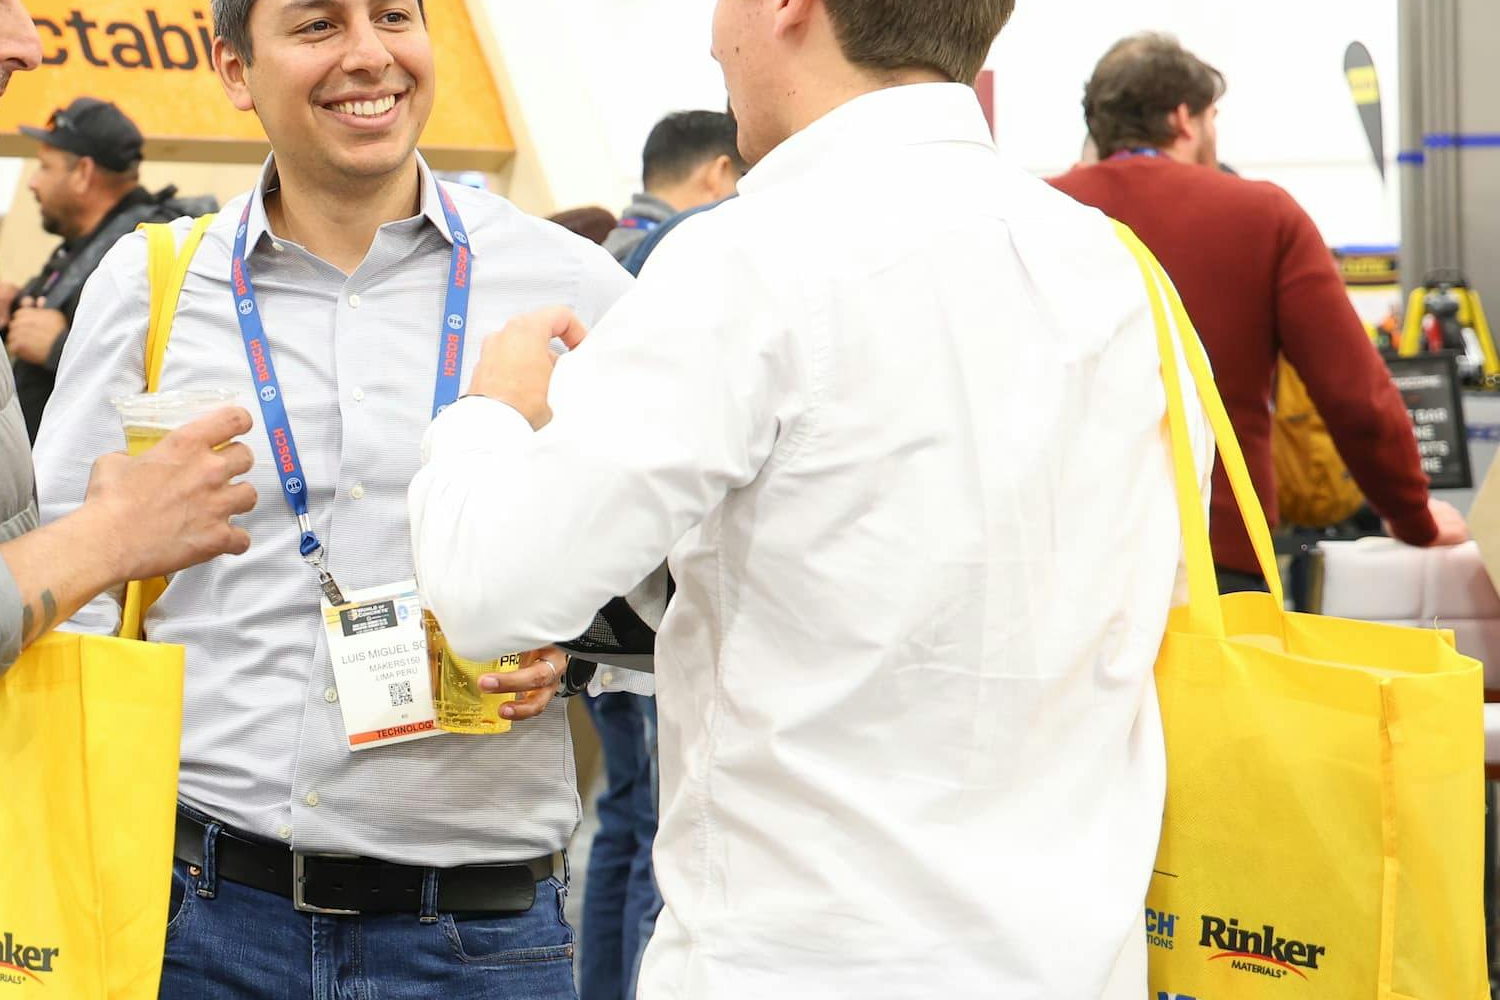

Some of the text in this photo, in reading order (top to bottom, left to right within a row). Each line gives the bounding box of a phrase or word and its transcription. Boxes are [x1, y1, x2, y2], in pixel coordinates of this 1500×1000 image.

[250, 338, 271, 382] BOSCH
[443, 333, 460, 377] BOSCH
[272, 427, 296, 473] BOSCH
[341, 652, 366, 665] LUIS
[368, 643, 408, 660] MIGUEL
[376, 667, 418, 682] LIMA PERU
[1199, 915, 1326, 969] Rinker
[1231, 960, 1282, 978] MATERIALS
